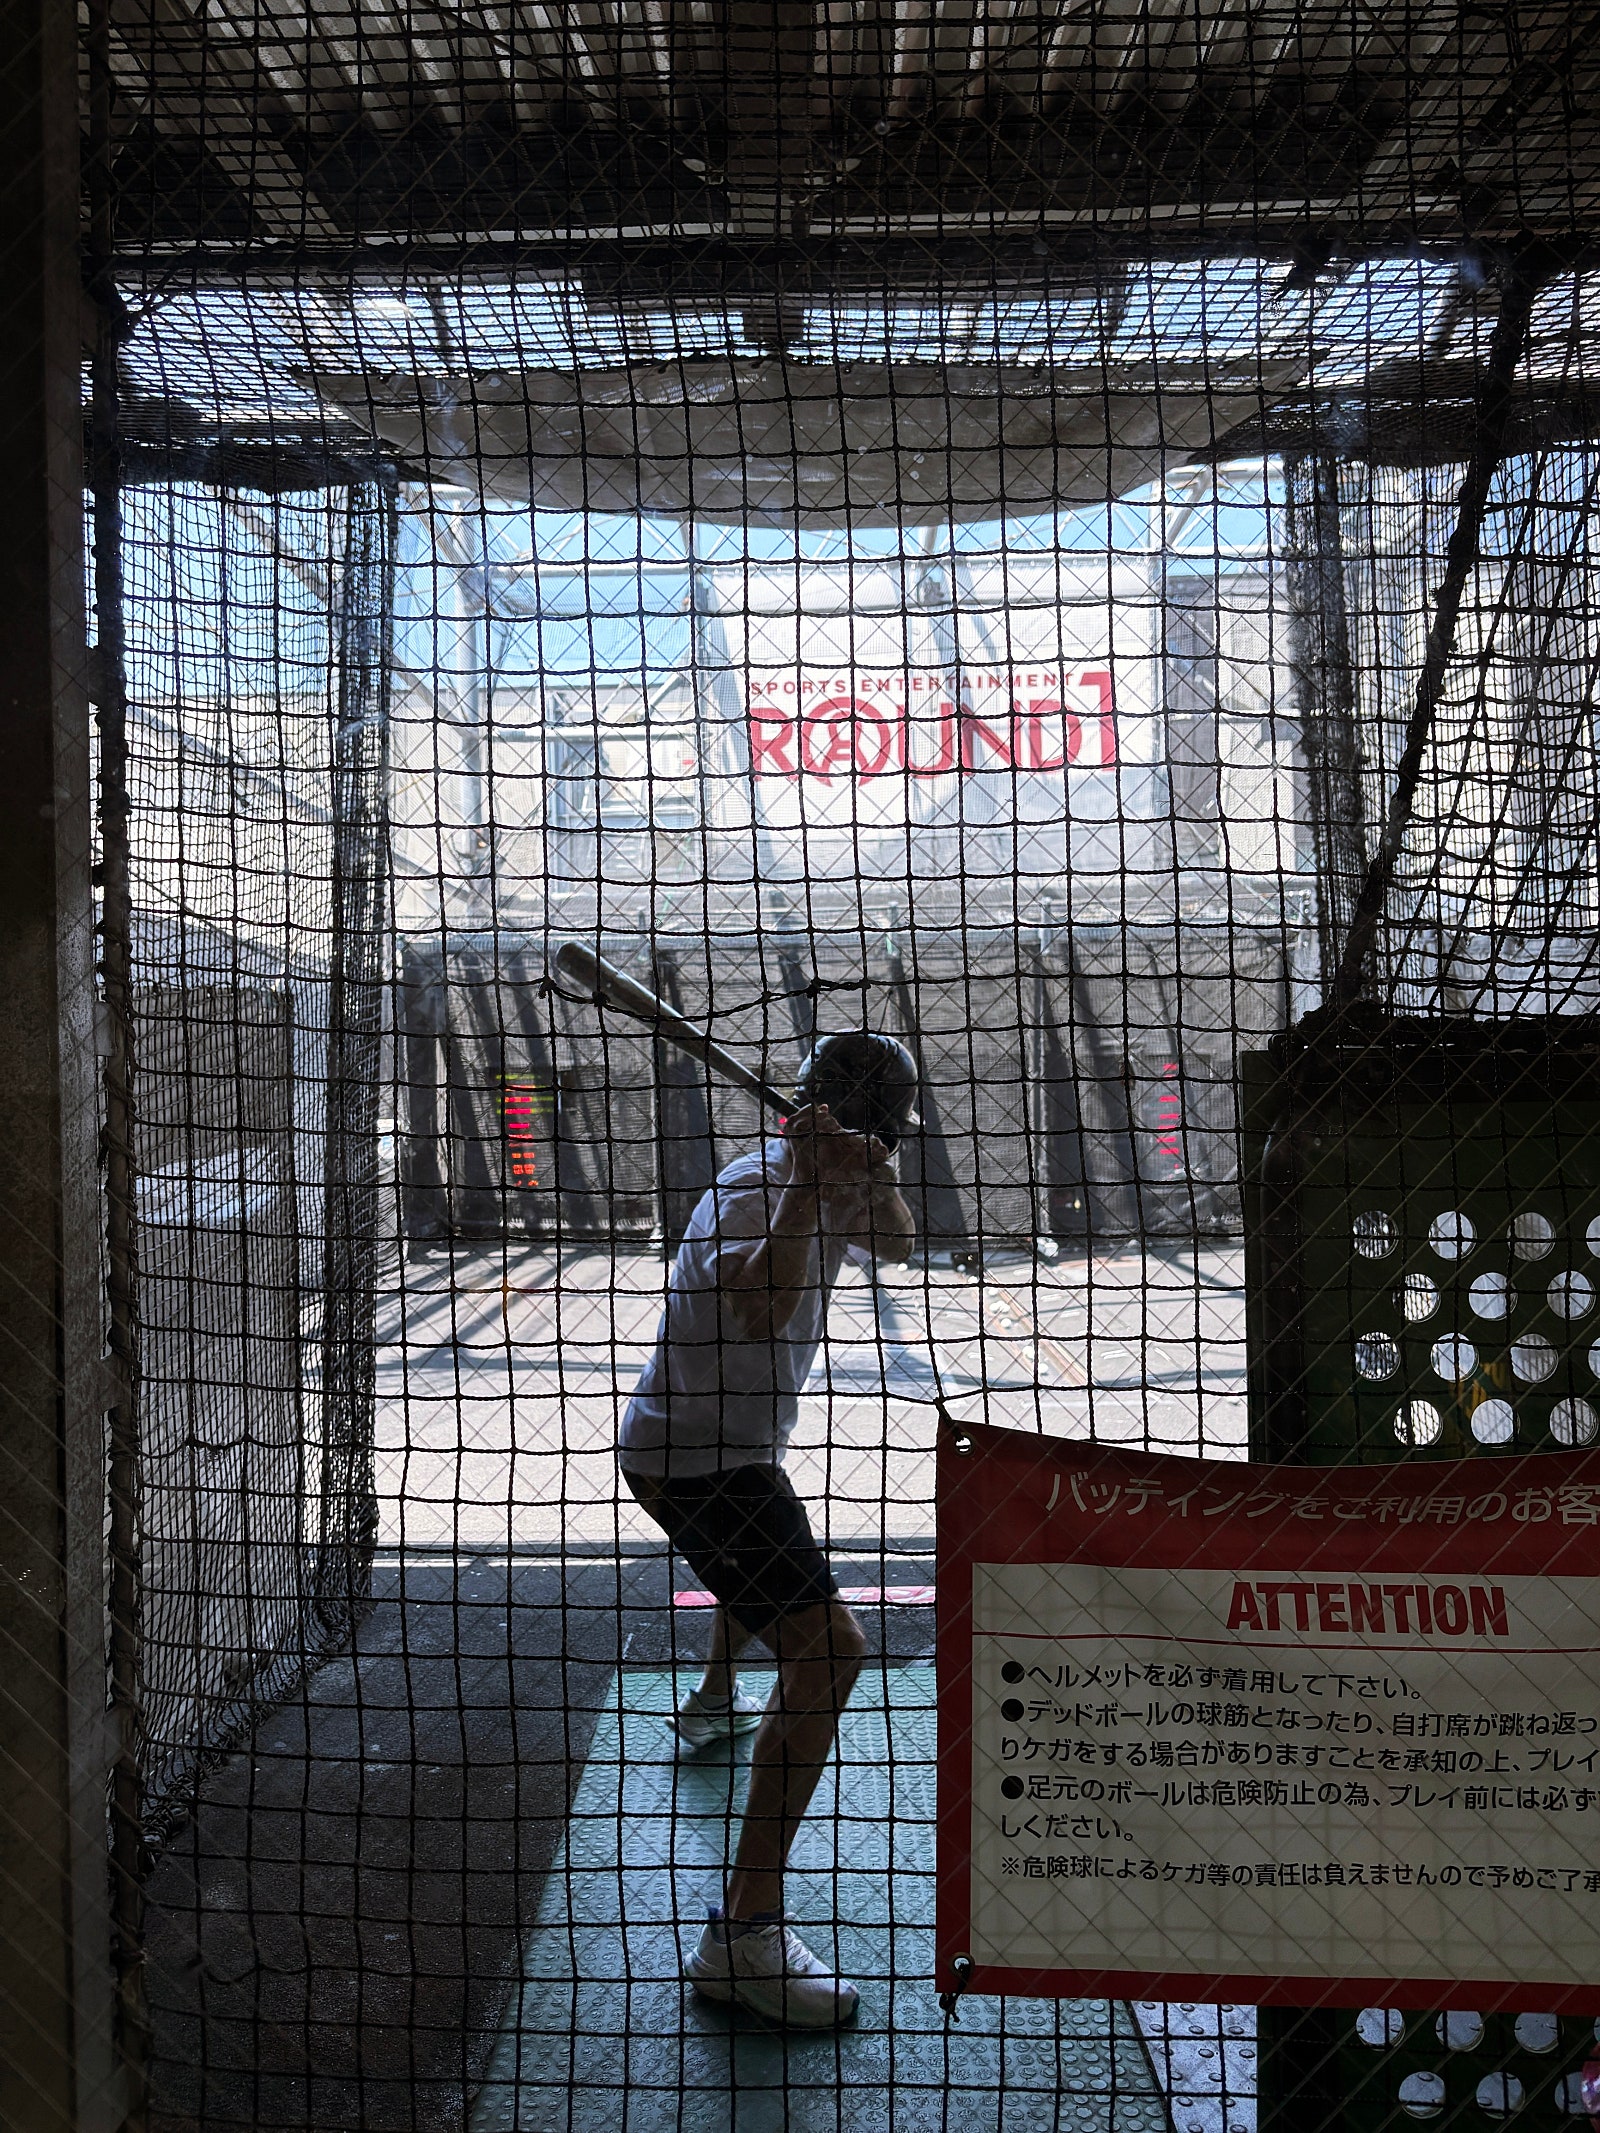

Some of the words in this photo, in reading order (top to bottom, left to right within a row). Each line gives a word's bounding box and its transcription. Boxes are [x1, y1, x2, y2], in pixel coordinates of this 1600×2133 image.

[750, 679, 846, 696] SPORTS
[1226, 1581, 1509, 1636] ATTENTION
[1027, 1774, 1600, 1812] 足元のボールは危険防止の為、プレイ前には必ず
[1001, 1813, 1134, 1842] しください。
